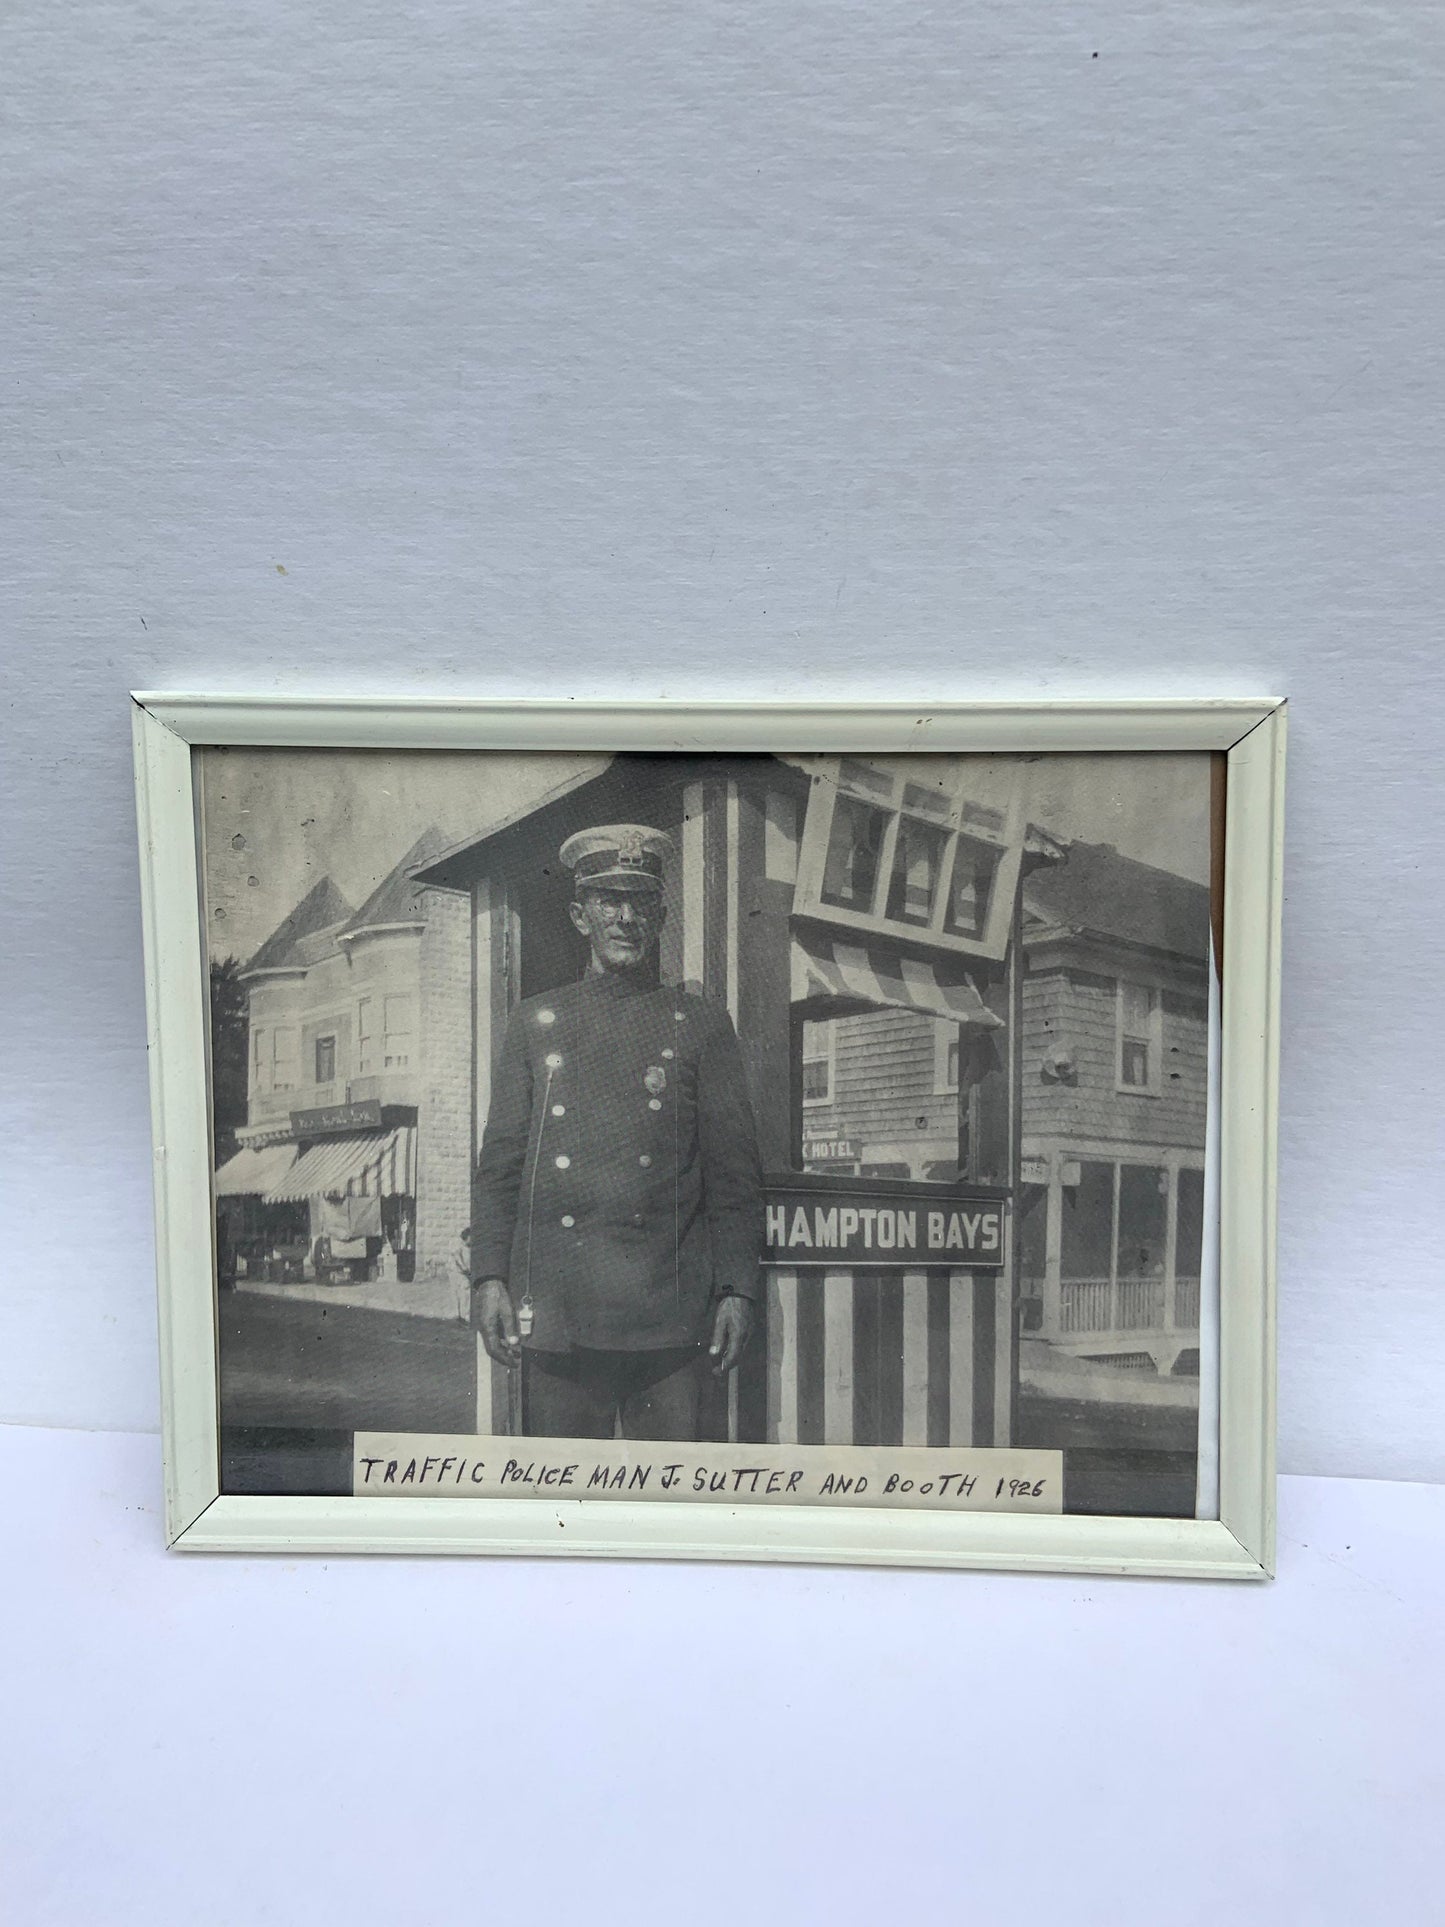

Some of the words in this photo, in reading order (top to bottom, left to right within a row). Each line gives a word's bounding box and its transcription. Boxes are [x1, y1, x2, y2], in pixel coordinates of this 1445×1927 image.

[811, 1141, 855, 1157] HOTEL
[766, 1205, 917, 1248] HAMPTON
[927, 1211, 999, 1250] BAYS
[359, 1456, 486, 1485] TRAFFIC
[500, 1459, 579, 1485] POLICE
[587, 1464, 652, 1490] MAN
[692, 1466, 804, 1493] SUTTER
[818, 1473, 868, 1496] AND
[882, 1473, 978, 1497] BOOTH
[994, 1477, 1047, 1498] 1926
